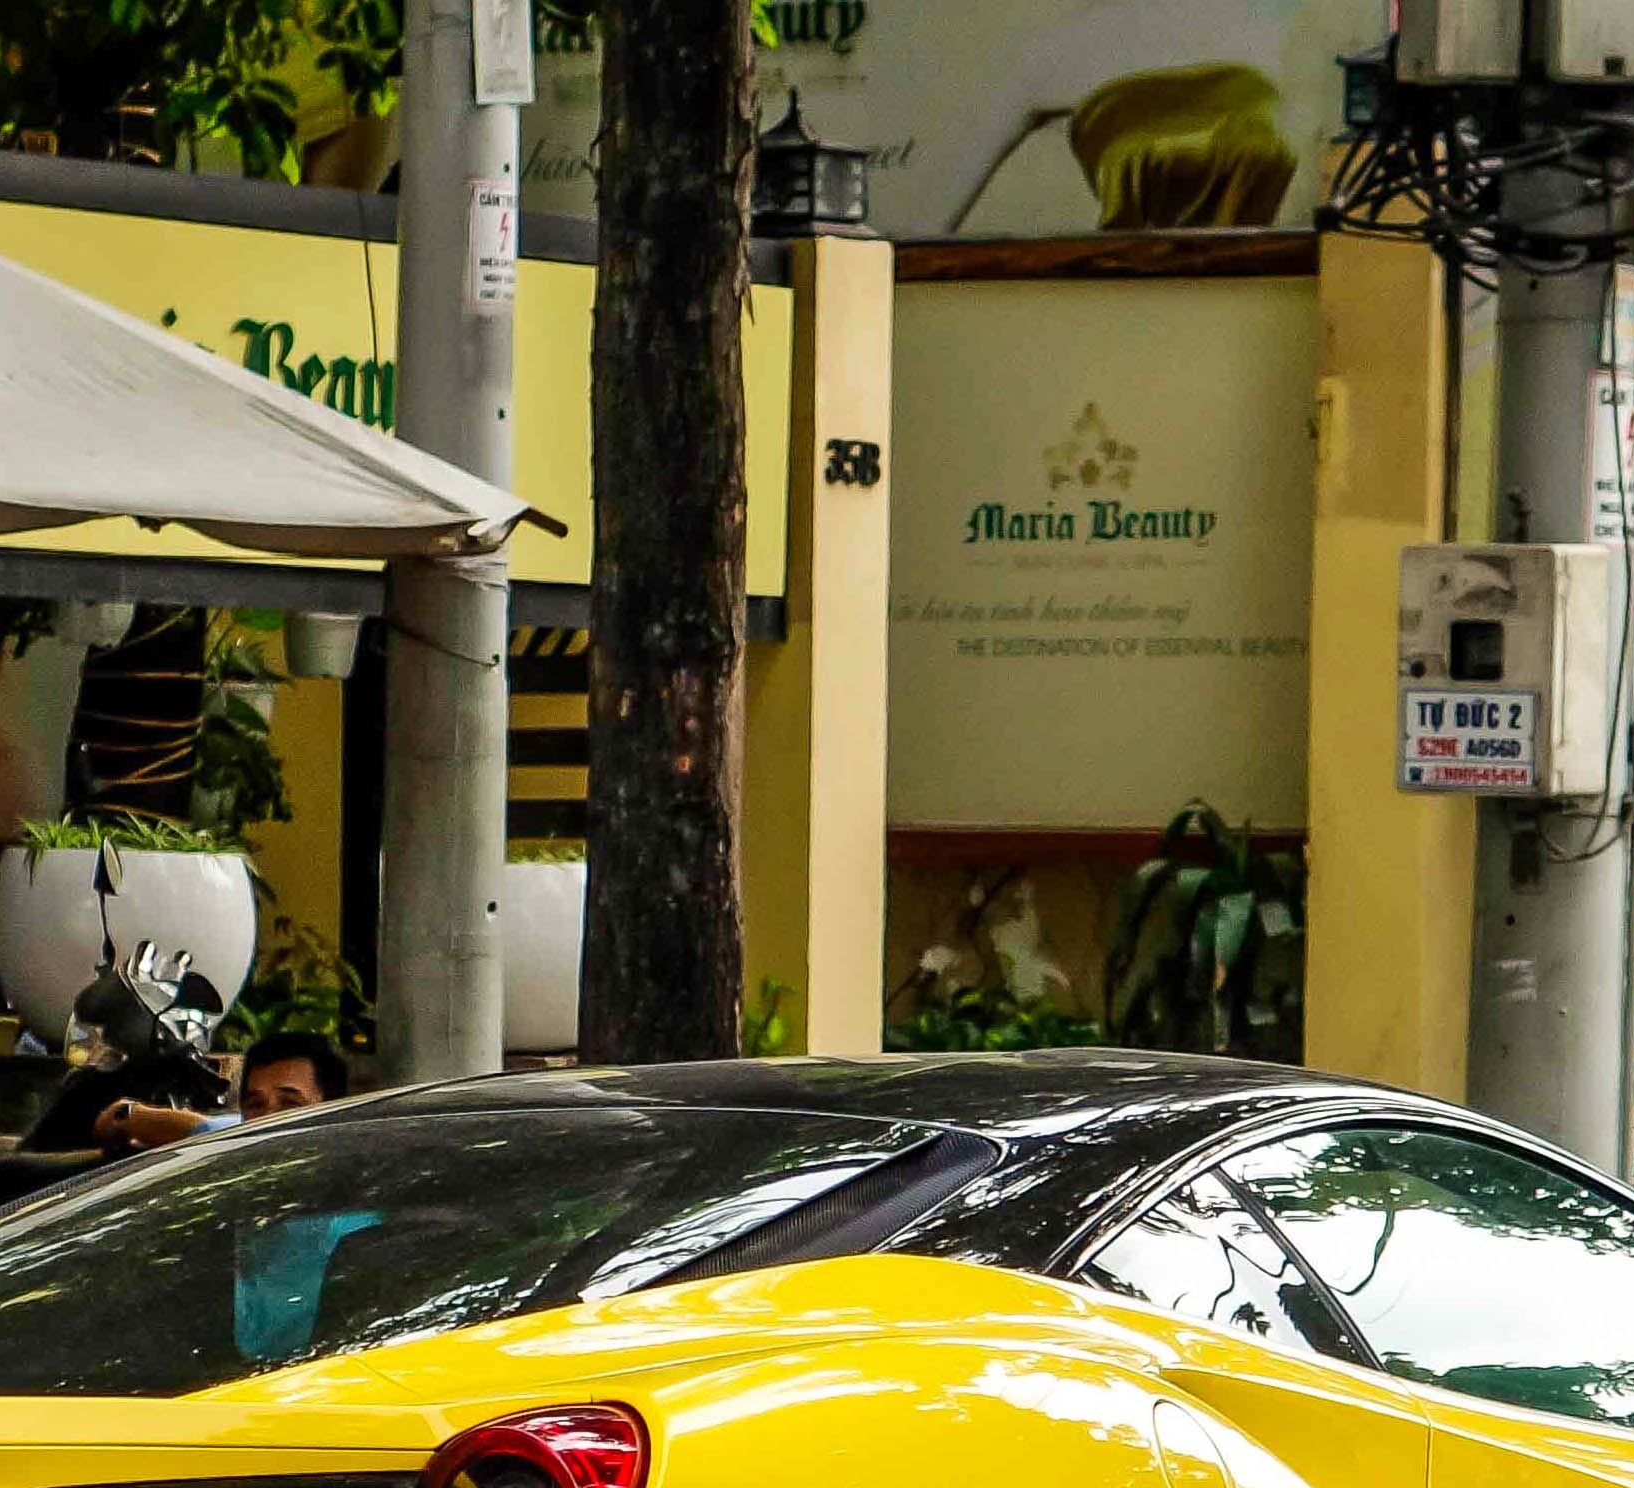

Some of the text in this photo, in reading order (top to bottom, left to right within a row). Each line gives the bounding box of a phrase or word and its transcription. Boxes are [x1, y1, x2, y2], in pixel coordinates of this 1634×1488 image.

[231, 317, 395, 431] Beau
[963, 500, 1217, 547] Maria Beauty
[955, 638, 985, 657] THE
[992, 637, 1104, 657] DESTINATION
[1111, 637, 1140, 657] OF
[1508, 704, 1522, 729] 2
